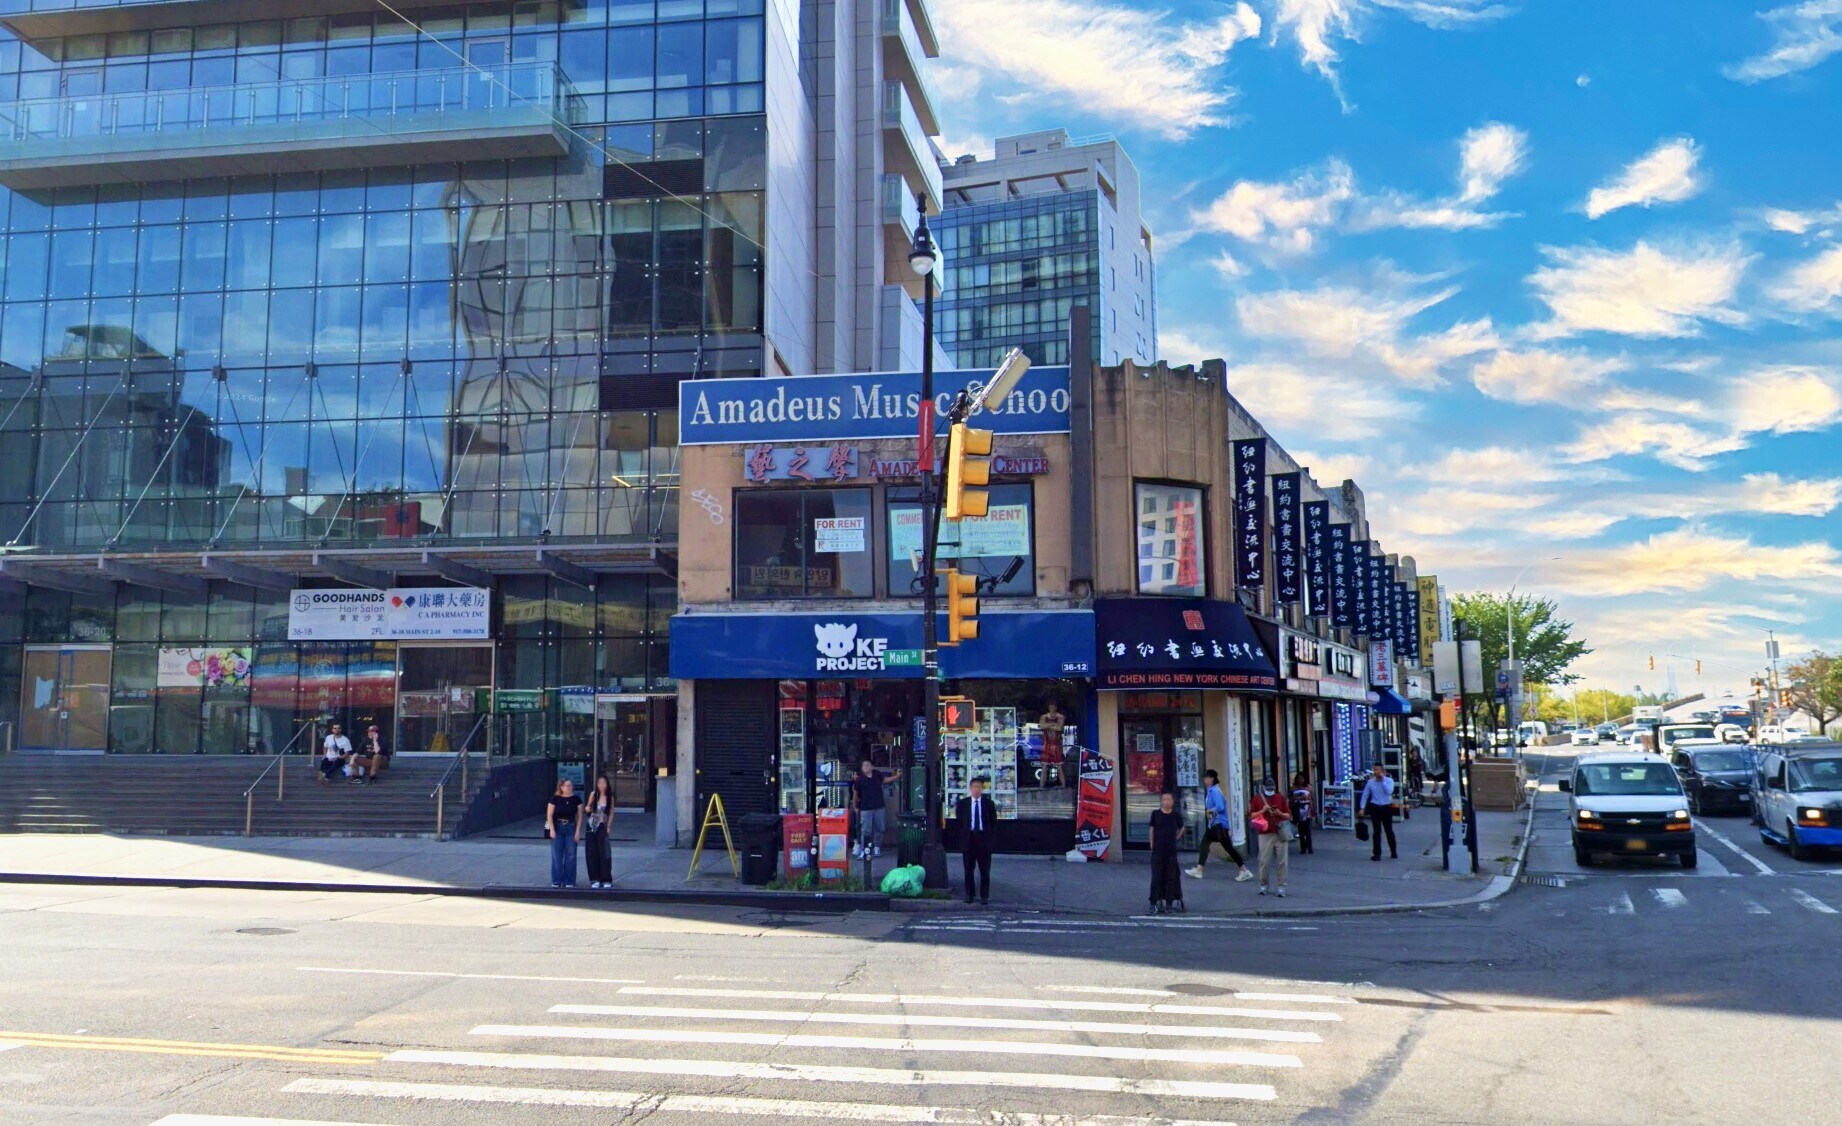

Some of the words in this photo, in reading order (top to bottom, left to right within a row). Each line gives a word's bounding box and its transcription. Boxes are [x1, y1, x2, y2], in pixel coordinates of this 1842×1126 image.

[690, 385, 841, 424] Amadeus
[852, 383, 950, 420] Musc
[966, 379, 1070, 417] Shoo
[868, 459, 920, 477] AMADE
[993, 455, 1050, 473] CENTER
[990, 509, 1022, 521] RENT
[816, 521, 835, 529] FOR
[837, 520, 862, 528] RENT
[313, 593, 385, 603] GOODHANDS
[418, 592, 485, 608] 康聯大藥房
[340, 604, 358, 613] Hair
[360, 604, 385, 613] Salon
[292, 627, 313, 635] 36-18
[371, 627, 383, 635] 2FL
[889, 652, 909, 664] Main
[911, 650, 917, 658] St
[816, 658, 885, 670] PROJECT
[1063, 663, 1088, 671] 36-12
[1108, 675, 1117, 684] LI
[1119, 675, 1146, 684] CHEN
[1148, 675, 1171, 684] HING
[1173, 674, 1193, 684] NEW
[1196, 674, 1219, 684] YORK
[1220, 675, 1249, 685] CHINESE
[1250, 676, 1260, 685] ART
